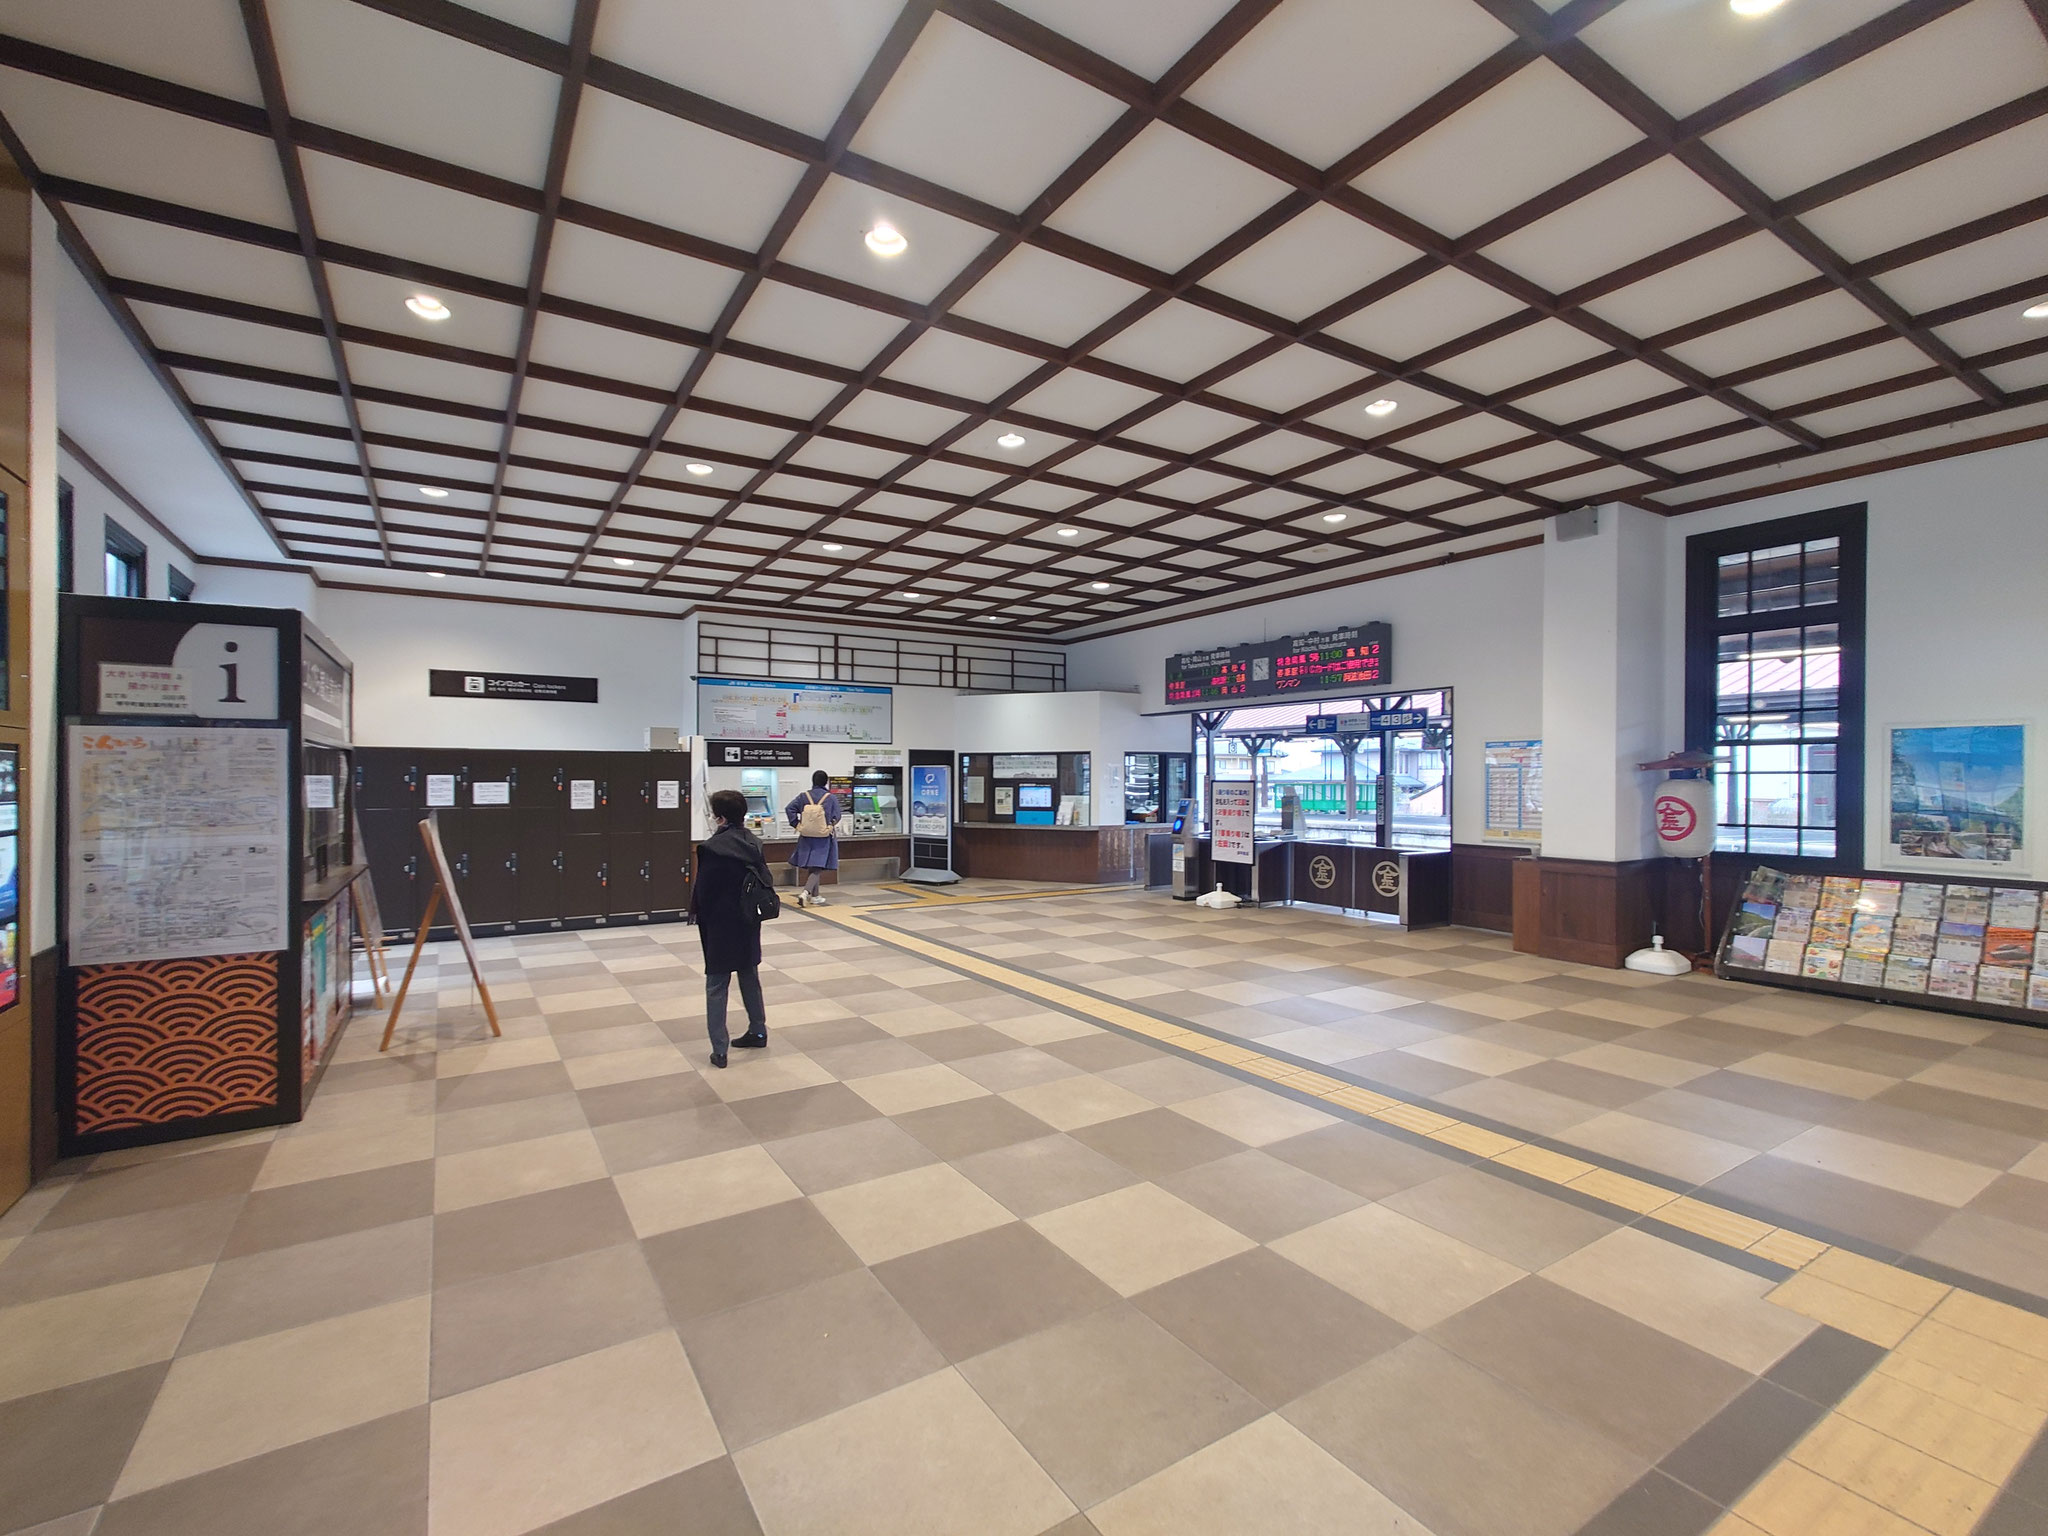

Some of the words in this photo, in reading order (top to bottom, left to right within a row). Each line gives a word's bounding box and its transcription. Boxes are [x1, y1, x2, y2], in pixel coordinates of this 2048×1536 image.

[1372, 644, 1380, 654] 2
[1240, 662, 1246, 671] 4
[1371, 669, 1380, 679] 2
[1240, 683, 1246, 693] 2
